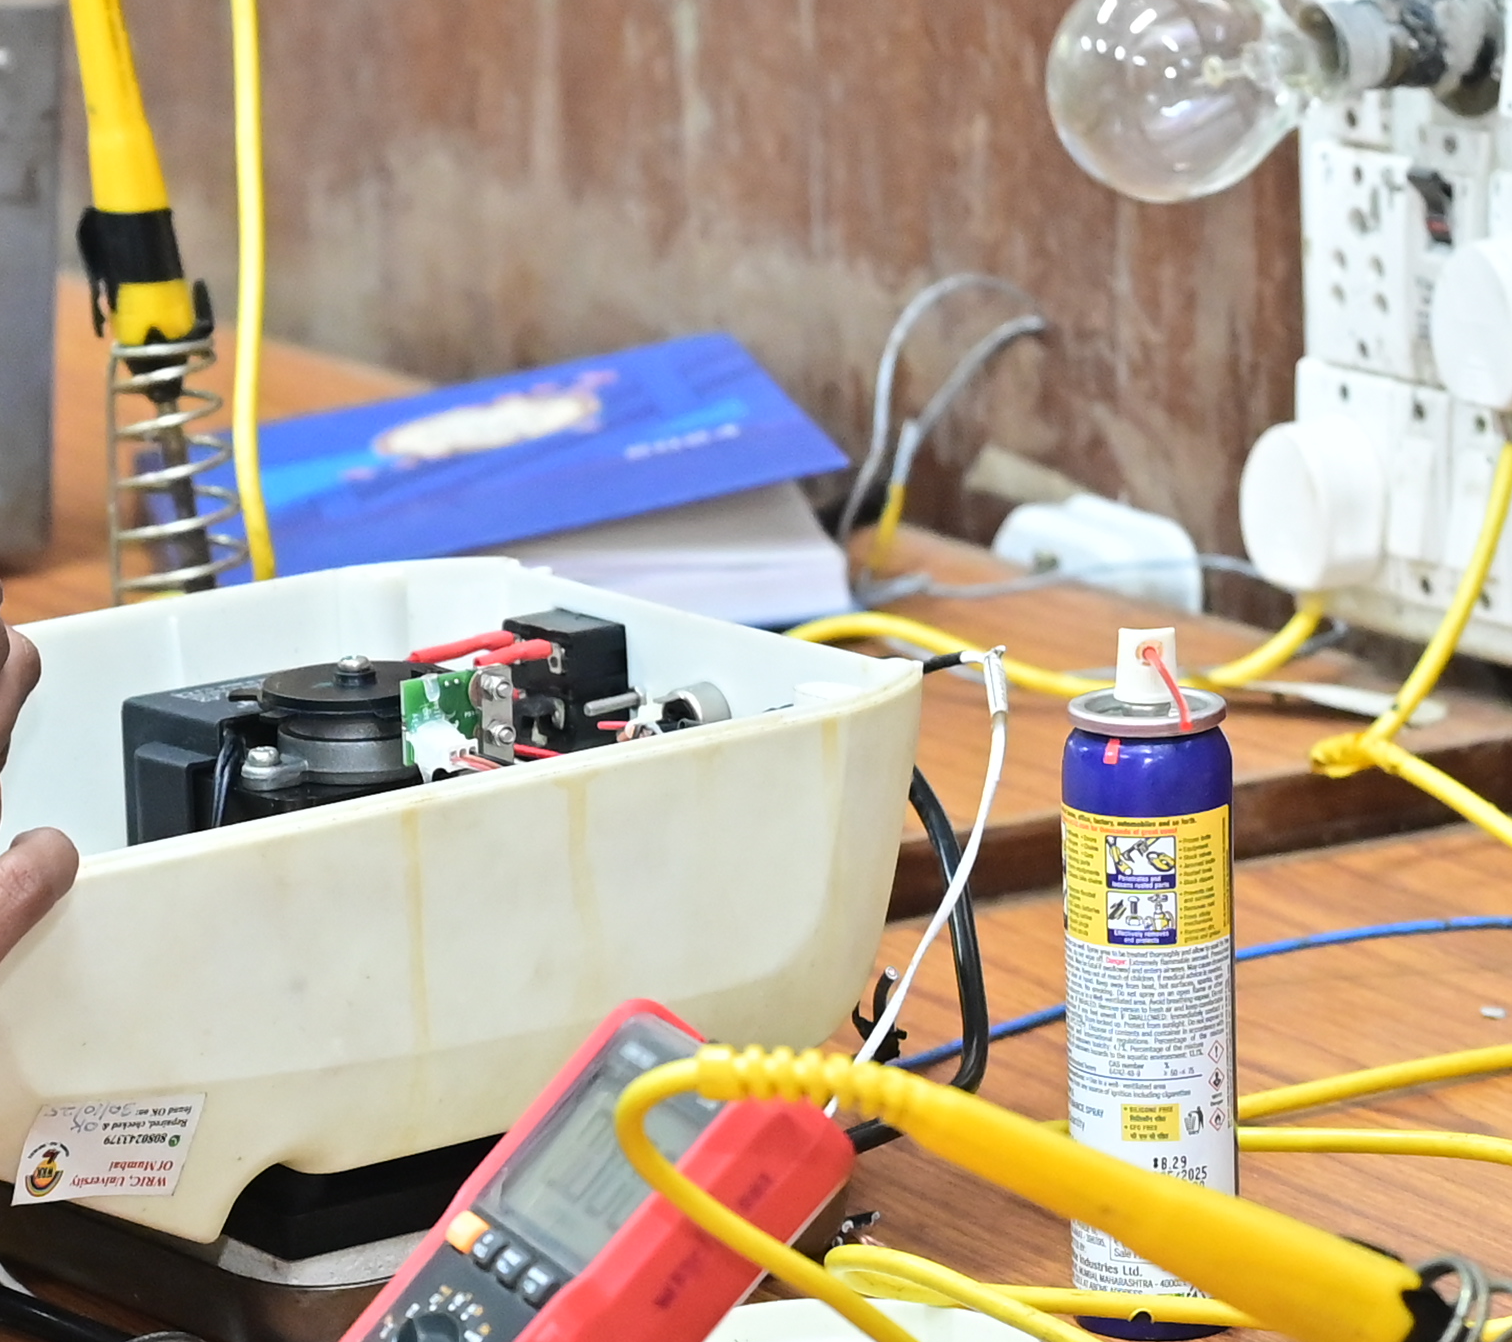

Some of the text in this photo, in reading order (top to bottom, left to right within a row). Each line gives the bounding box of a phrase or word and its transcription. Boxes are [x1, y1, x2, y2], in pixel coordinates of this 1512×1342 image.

[152, 1107, 166, 1116] OK
[168, 1105, 193, 1115] found
[102, 1118, 188, 1131] Repaired, checked &
[109, 1161, 173, 1171] Of Mumbai
[70, 1175, 168, 1188] WRIC, University
[1080, 1255, 1143, 1277] Industries Ltd.
[1099, 1275, 1153, 1288] MAHARASHTRA
